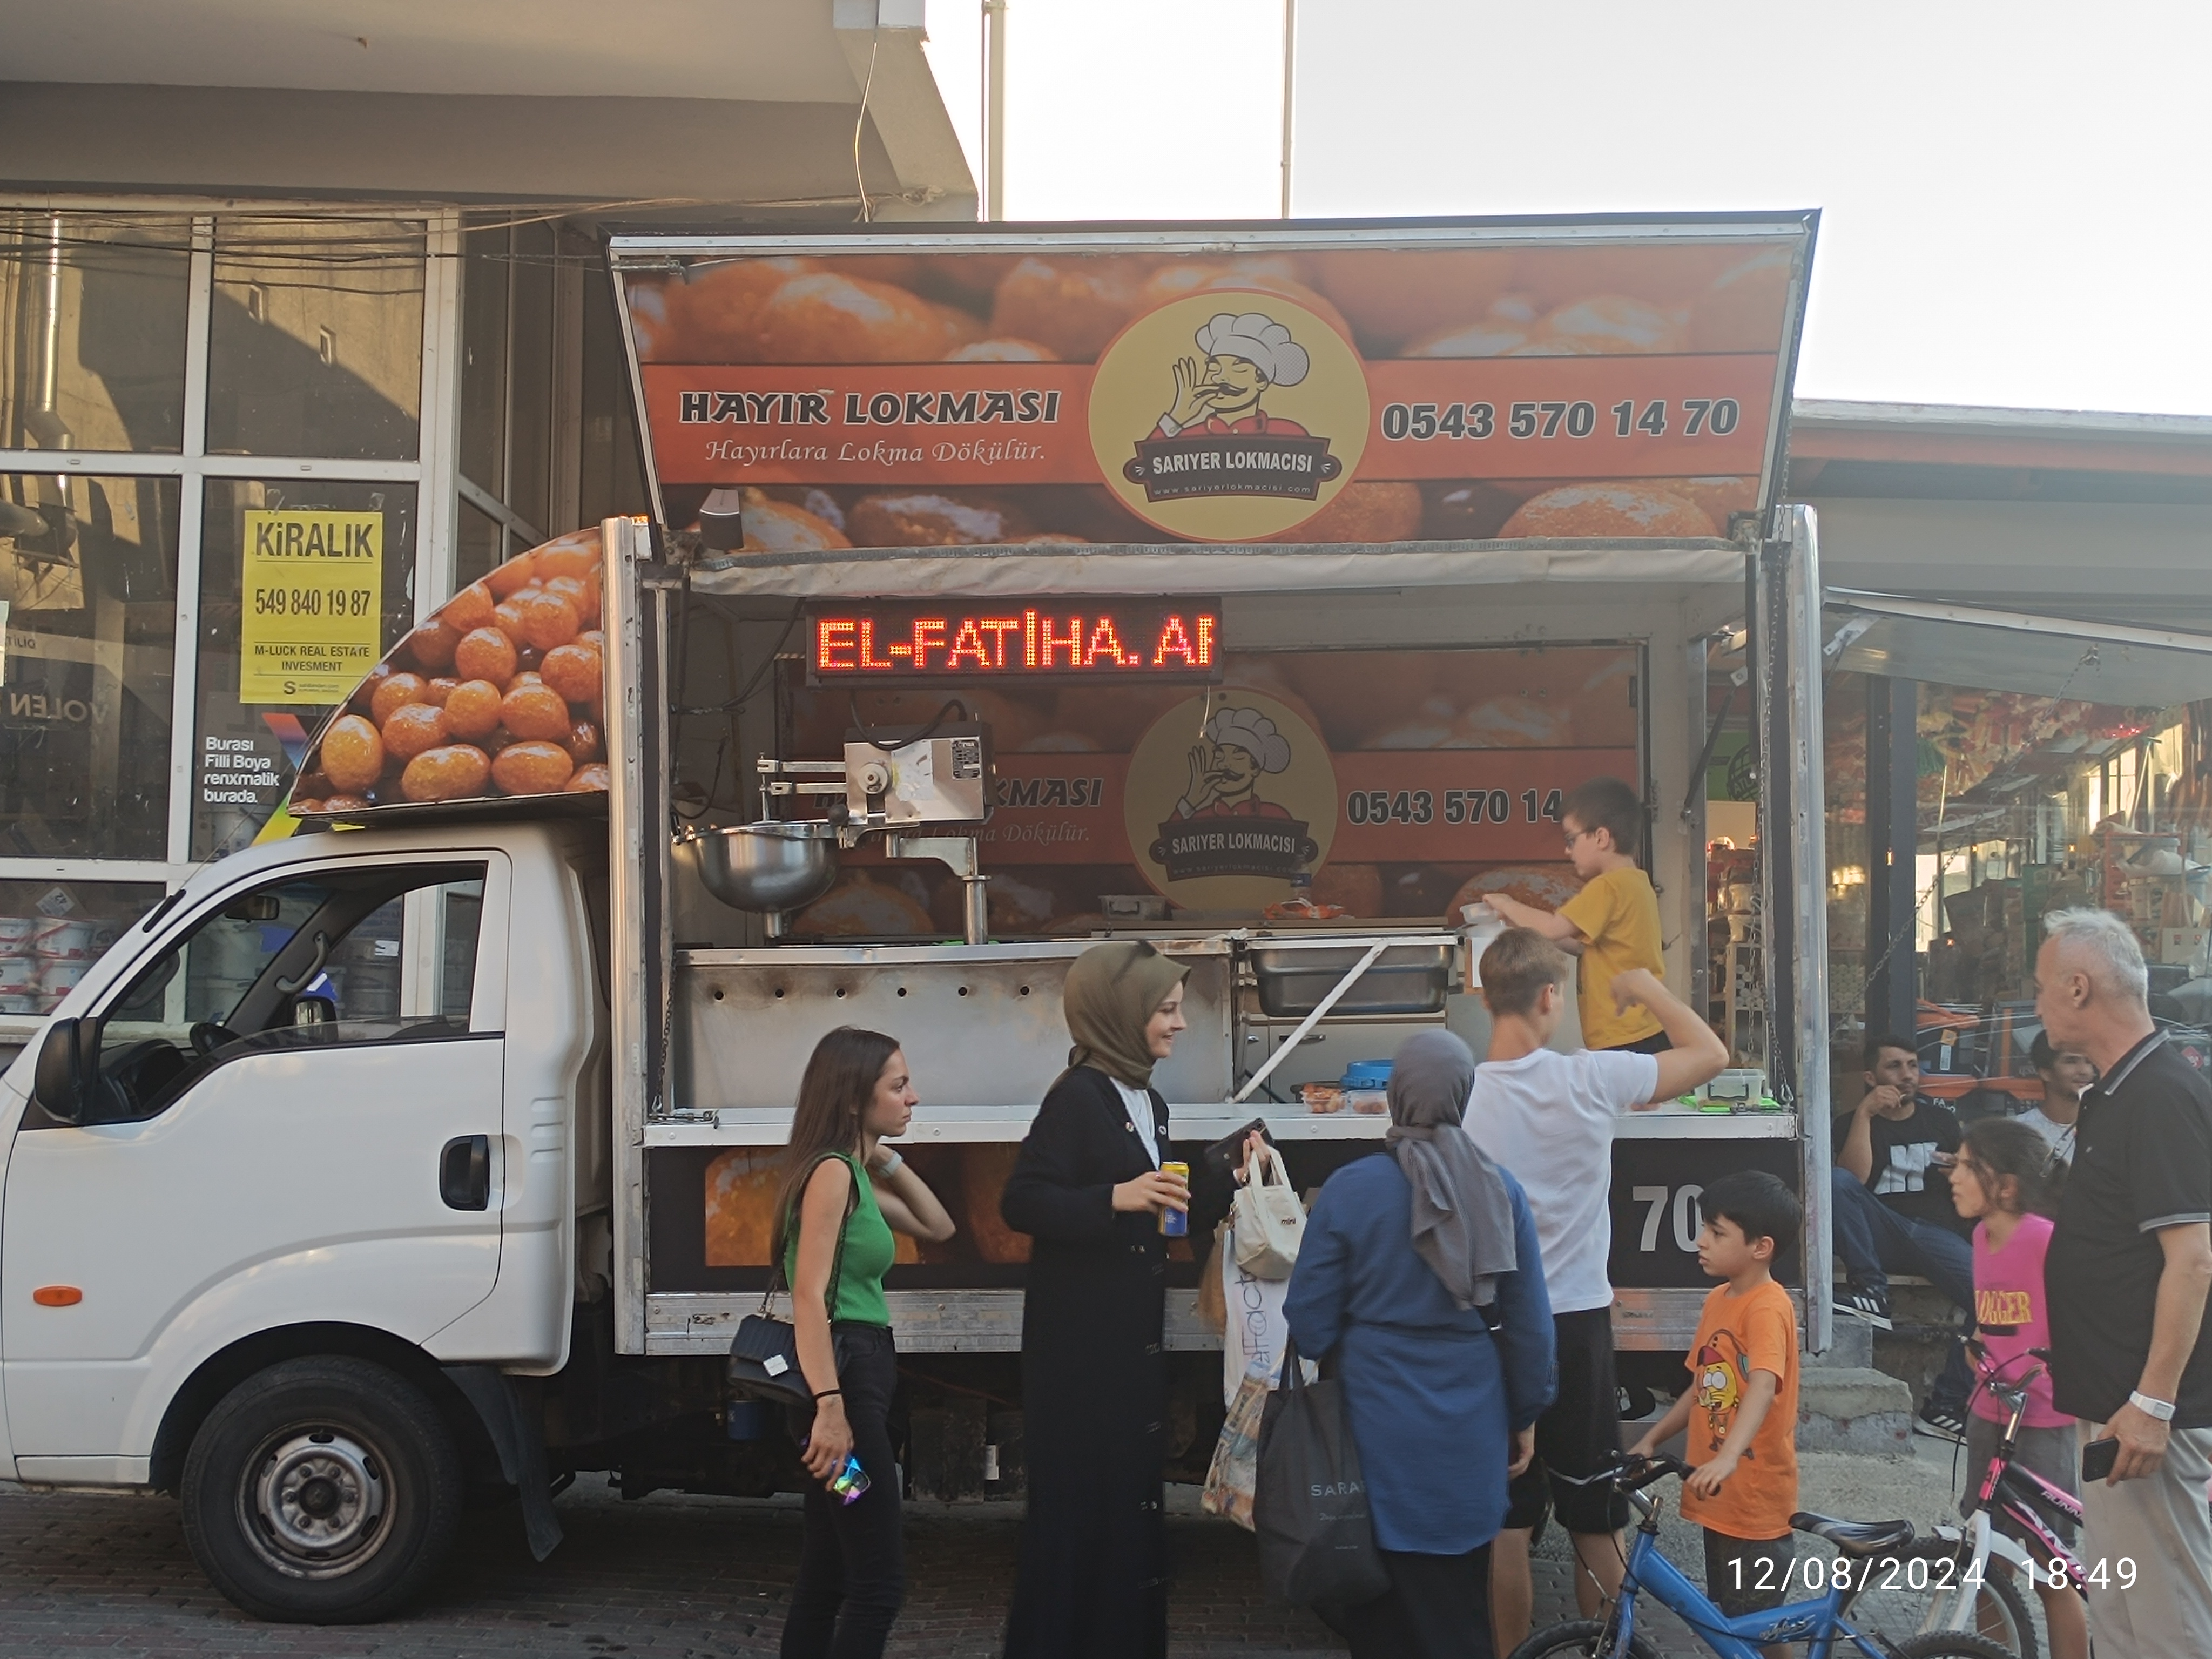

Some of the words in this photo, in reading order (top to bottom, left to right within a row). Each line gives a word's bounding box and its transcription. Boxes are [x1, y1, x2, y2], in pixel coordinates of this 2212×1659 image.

[679, 391, 831, 425] HAYIR
[844, 390, 1062, 425] LOKMASI
[1381, 402, 1495, 441] 0543
[1508, 400, 1596, 439] 570
[1611, 399, 1668, 437] 14
[1682, 397, 1740, 436] 70
[705, 439, 828, 467] Hayırlara
[837, 440, 924, 466] Lokma
[932, 439, 1045, 466] Dökülür.
[1152, 452, 1221, 474] SARIYER
[1225, 451, 1312, 473] LOKMACISI
[255, 589, 286, 615] 549
[291, 589, 321, 615] 840
[327, 590, 346, 616] 19
[350, 590, 371, 616] 87
[255, 645, 296, 656] M-LUCK
[300, 646, 326, 656] REAL
[331, 647, 369, 657] ESTATE
[282, 661, 342, 671] INVESMENT
[206, 736, 254, 751] Burası
[205, 754, 230, 768] Filli
[233, 754, 271, 772] Boya
[204, 788, 258, 803] burada.
[996, 778, 1104, 807] KMASI
[1347, 790, 1433, 825] 0543
[1444, 789, 1510, 824] 570
[1521, 788, 1562, 824] 14
[1002, 821, 1089, 846] Dökülür.
[1172, 833, 1225, 854] SARIYER
[1229, 833, 1295, 853] LOKMACISI
[1633, 1184, 1704, 1252] 70
